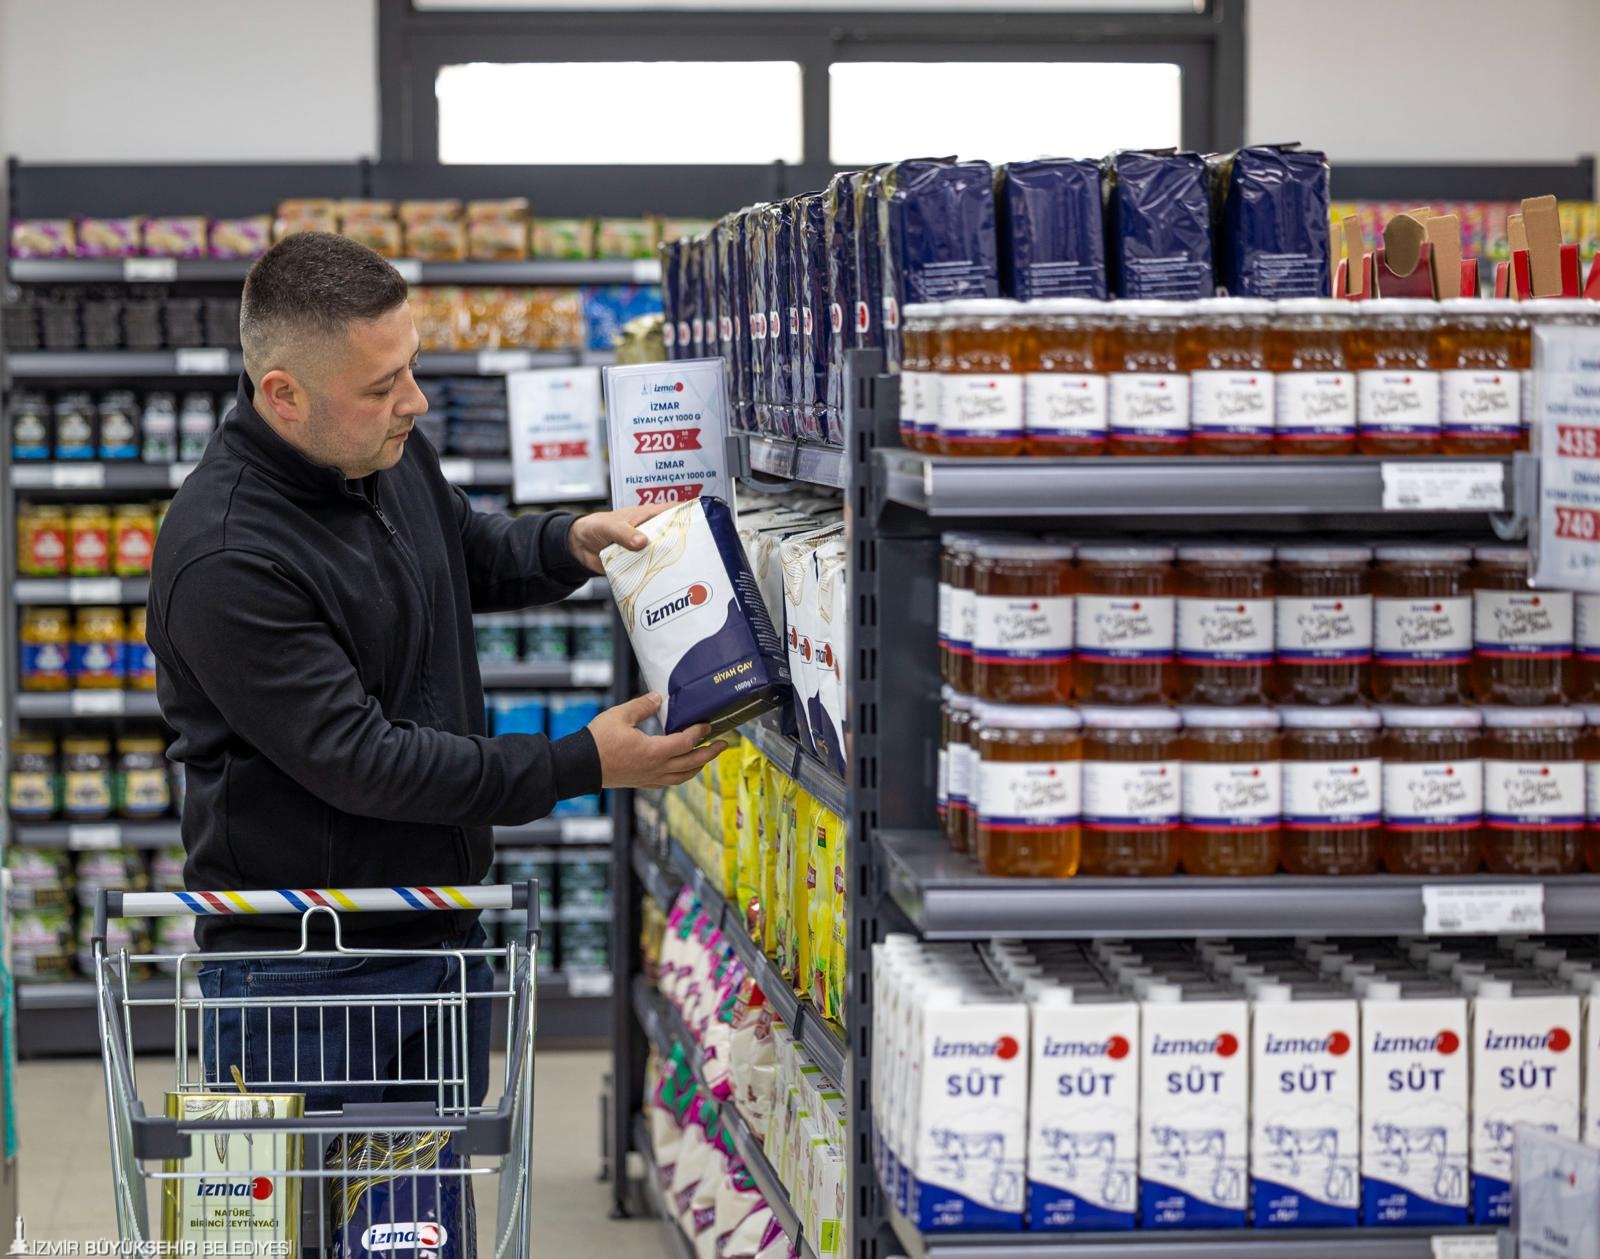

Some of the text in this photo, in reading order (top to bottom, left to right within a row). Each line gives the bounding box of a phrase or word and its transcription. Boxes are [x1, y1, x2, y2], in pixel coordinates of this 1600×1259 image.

[650, 402, 680, 411] İZMAR
[633, 417, 657, 425] SİYAH
[657, 415, 674, 425] ÇAY
[675, 413, 693, 422] 1000
[640, 432, 676, 452] 220
[655, 460, 685, 470] İZMAR
[625, 475, 643, 484] FİLİZ
[644, 474, 668, 483] SİYAH
[669, 472, 685, 482] ÇAY
[687, 471, 704, 480] 1000
[643, 489, 678, 504] 240
[645, 591, 693, 626] izmar
[713, 661, 753, 684] SİYAH ÇAY
[932, 1036, 1006, 1057] izmar
[1043, 1036, 1116, 1057] izmar
[1152, 1034, 1224, 1055] izmar
[1265, 1033, 1336, 1055] izmar
[1373, 1031, 1444, 1054] izmar
[1485, 1029, 1556, 1051] izmar
[947, 1069, 1005, 1096] SÜT
[1058, 1069, 1115, 1096] SÜT
[1167, 1066, 1225, 1094] SÜT
[1279, 1064, 1337, 1093] SÜT
[1388, 1063, 1446, 1092] SÜT
[1499, 1061, 1557, 1089] SÜT
[197, 1178, 257, 1196] izmar
[190, 1218, 224, 1227] BİRİNCİ
[214, 1208, 255, 1217] NATÜRE
[370, 1229, 420, 1244] izma
